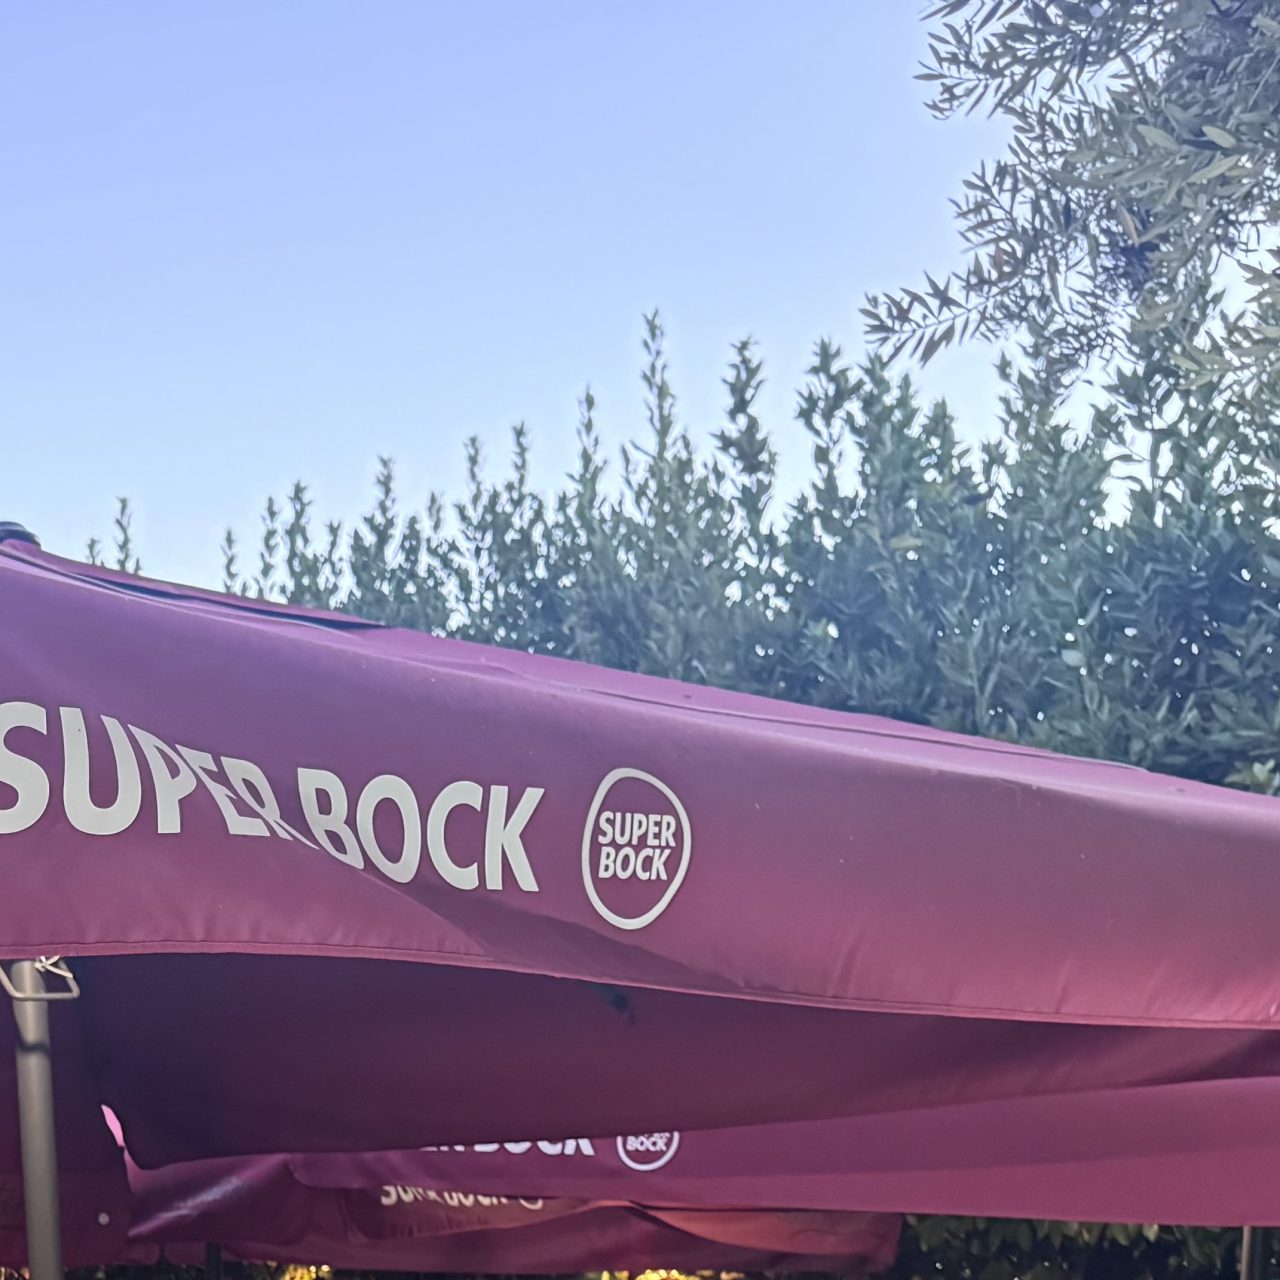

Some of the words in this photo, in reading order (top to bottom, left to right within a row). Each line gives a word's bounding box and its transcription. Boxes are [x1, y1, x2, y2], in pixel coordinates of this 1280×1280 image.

[297, 767, 546, 893] BOCK
[597, 811, 676, 847] SUPER
[598, 846, 672, 880] BOCK
